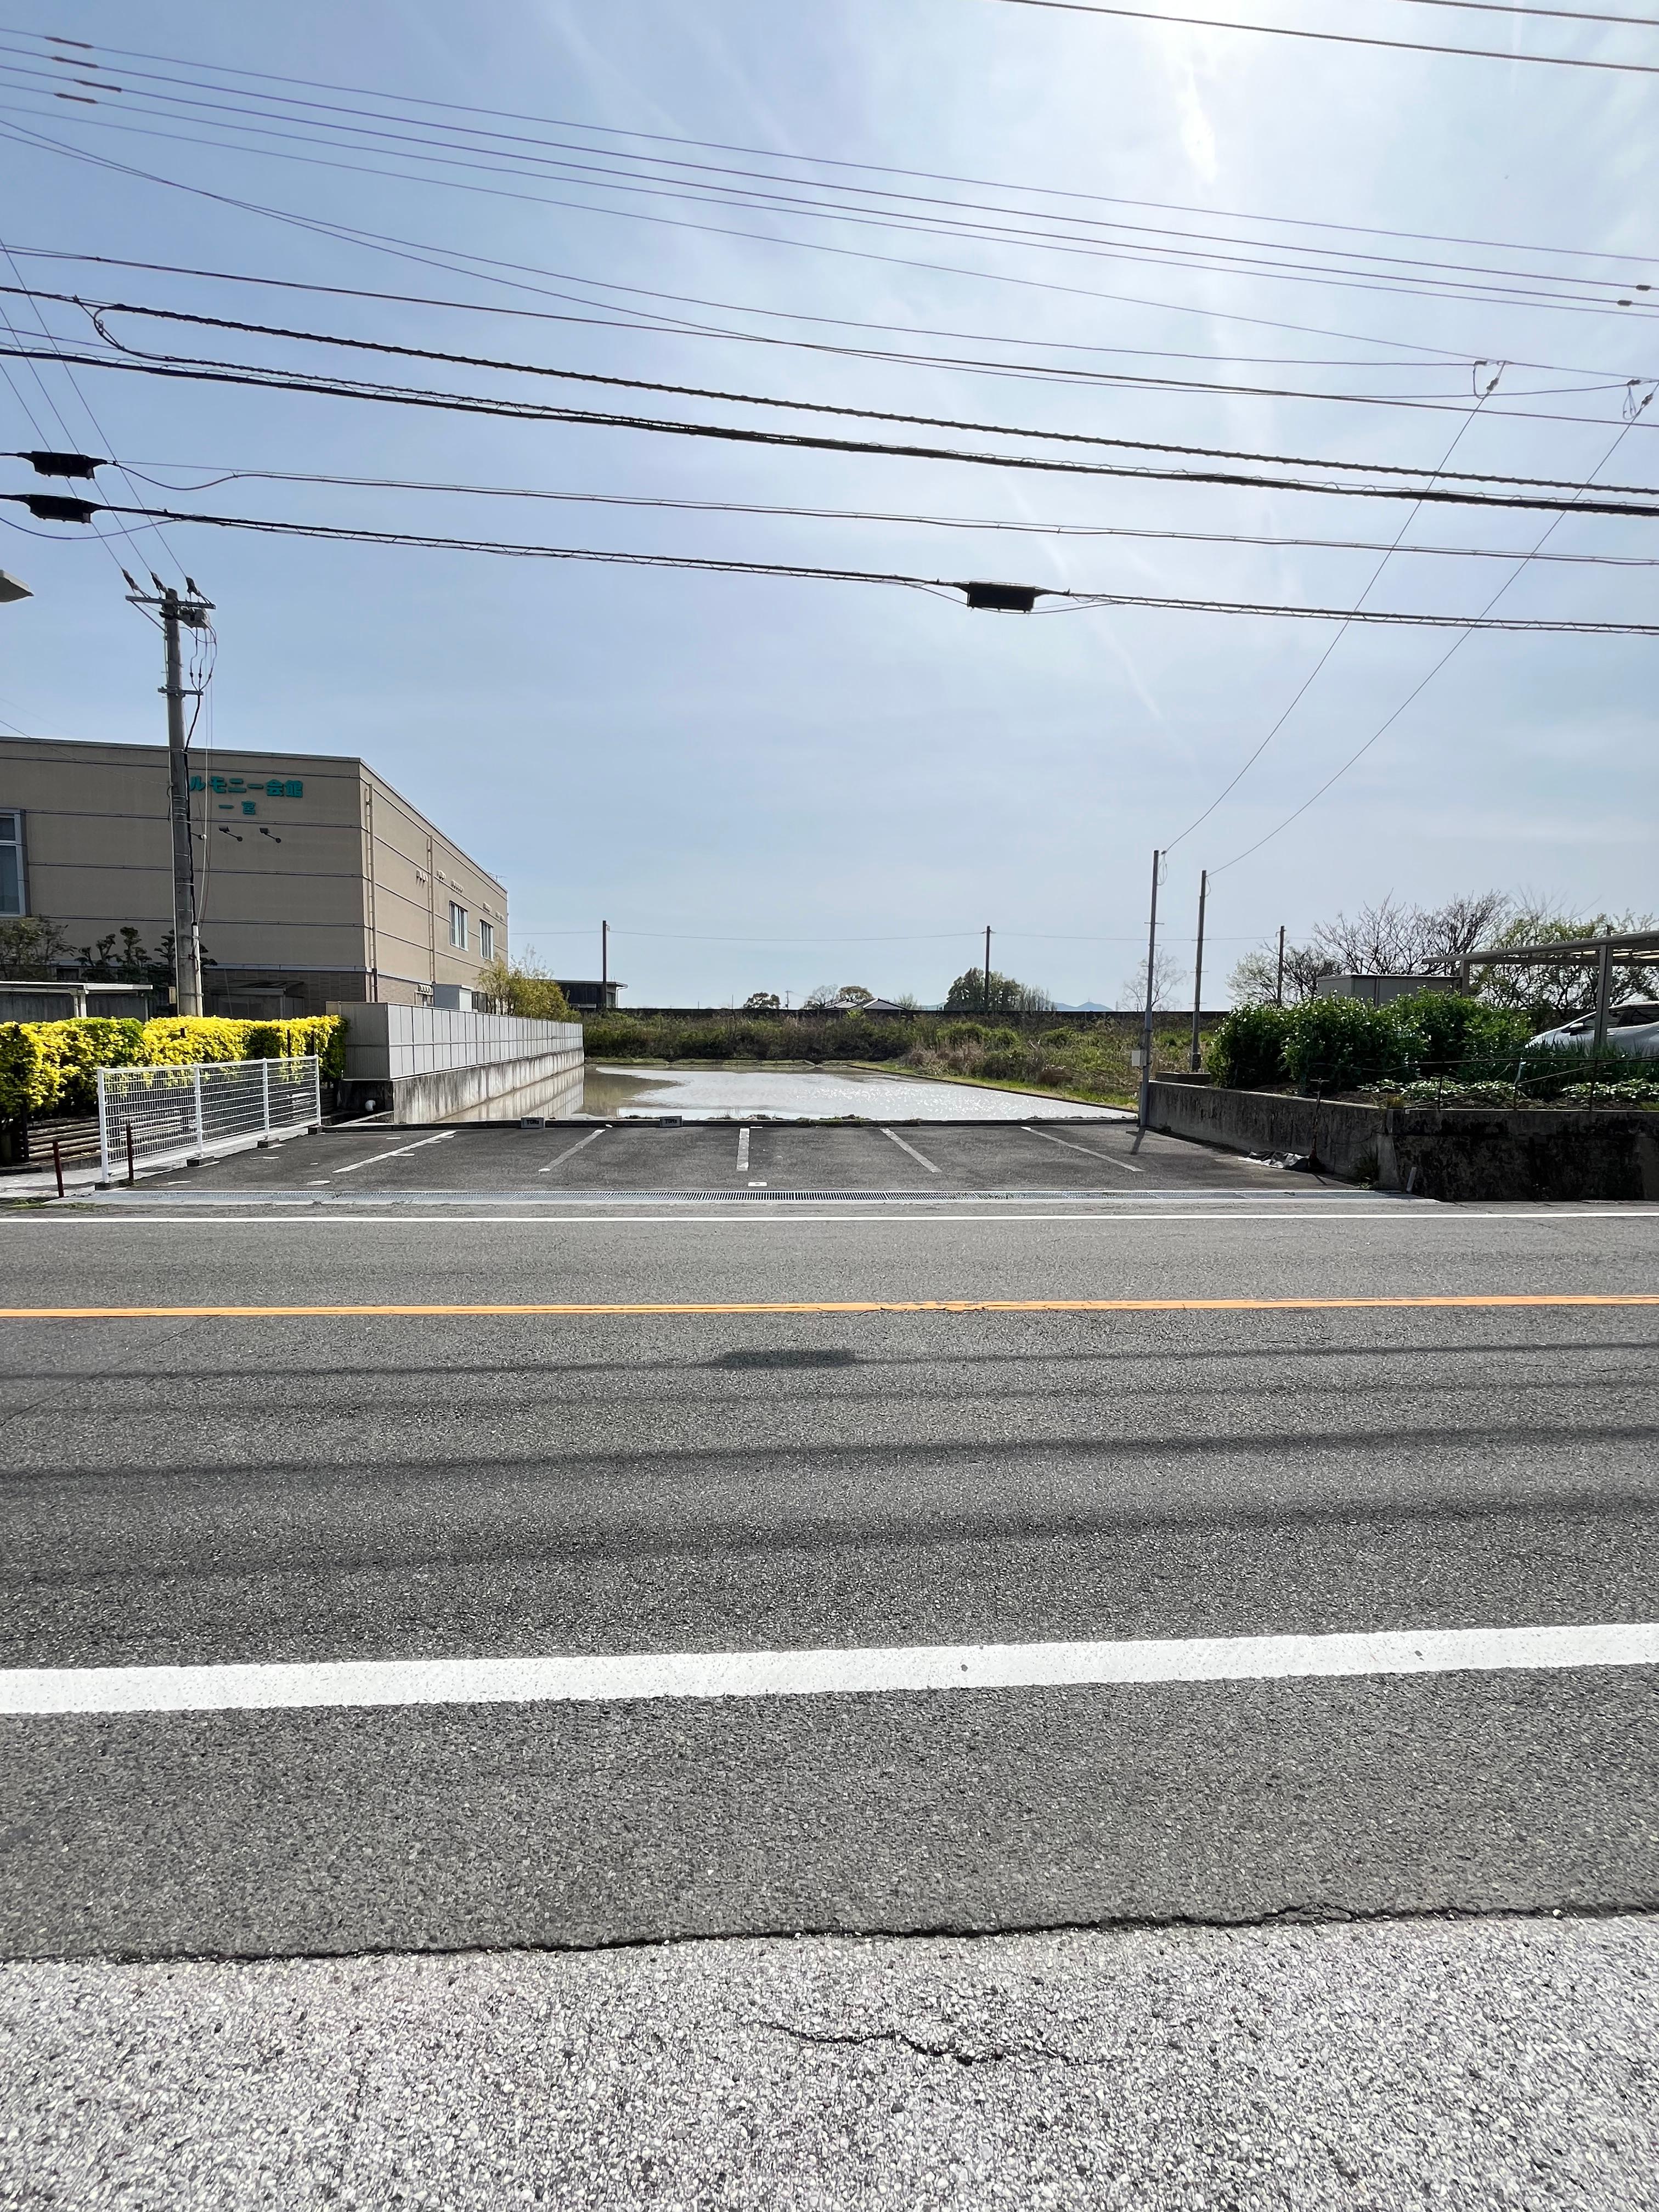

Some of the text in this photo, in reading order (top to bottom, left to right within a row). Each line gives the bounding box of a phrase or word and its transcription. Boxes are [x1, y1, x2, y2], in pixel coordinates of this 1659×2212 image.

[189, 775, 303, 798] ルモニー会館
